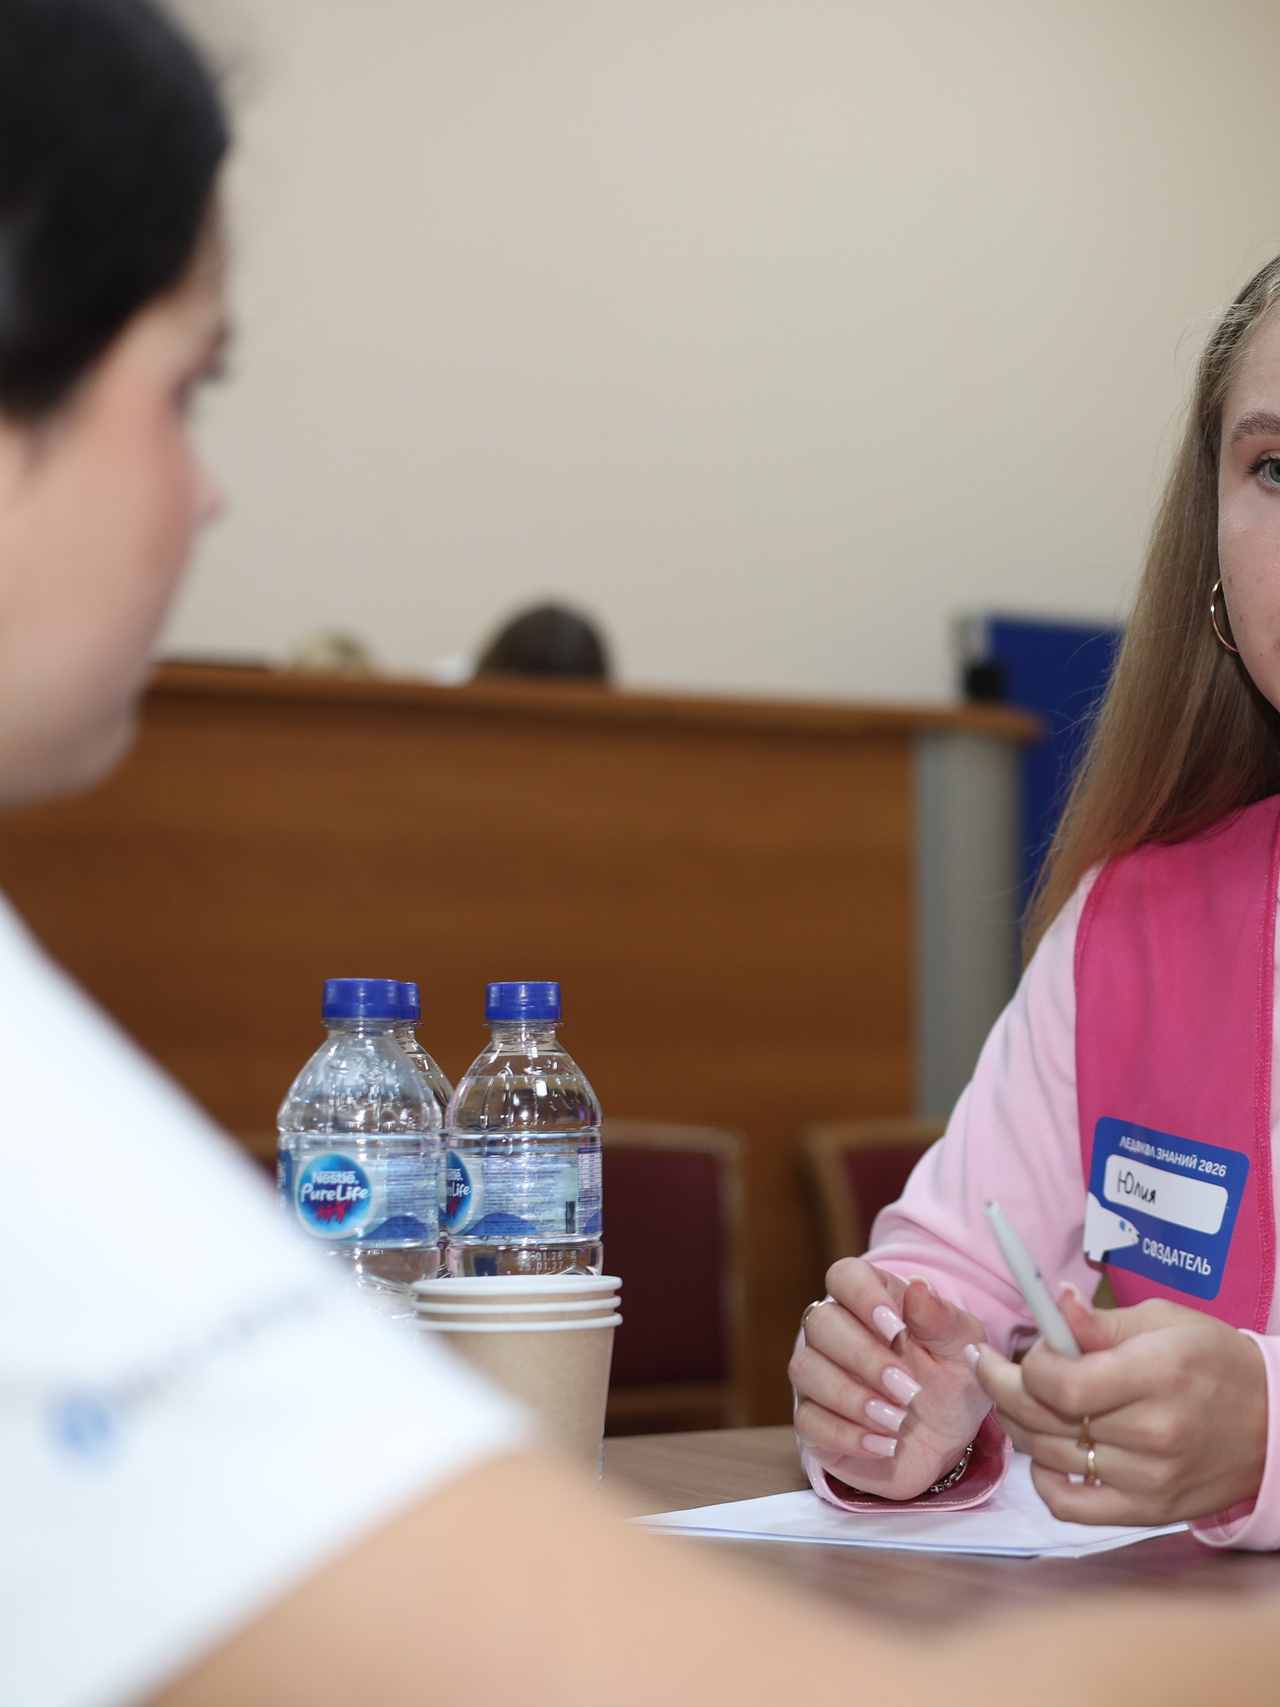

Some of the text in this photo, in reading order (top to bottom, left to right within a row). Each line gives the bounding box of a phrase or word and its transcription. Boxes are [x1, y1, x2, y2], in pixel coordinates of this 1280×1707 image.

[1155, 1147, 1198, 1170] ЗНАНИЙ
[1198, 1159, 1228, 1178] 2026
[1116, 1169, 1157, 1205] Юлия
[1142, 1237, 1213, 1276] СОЗДАТЕЛЬ
